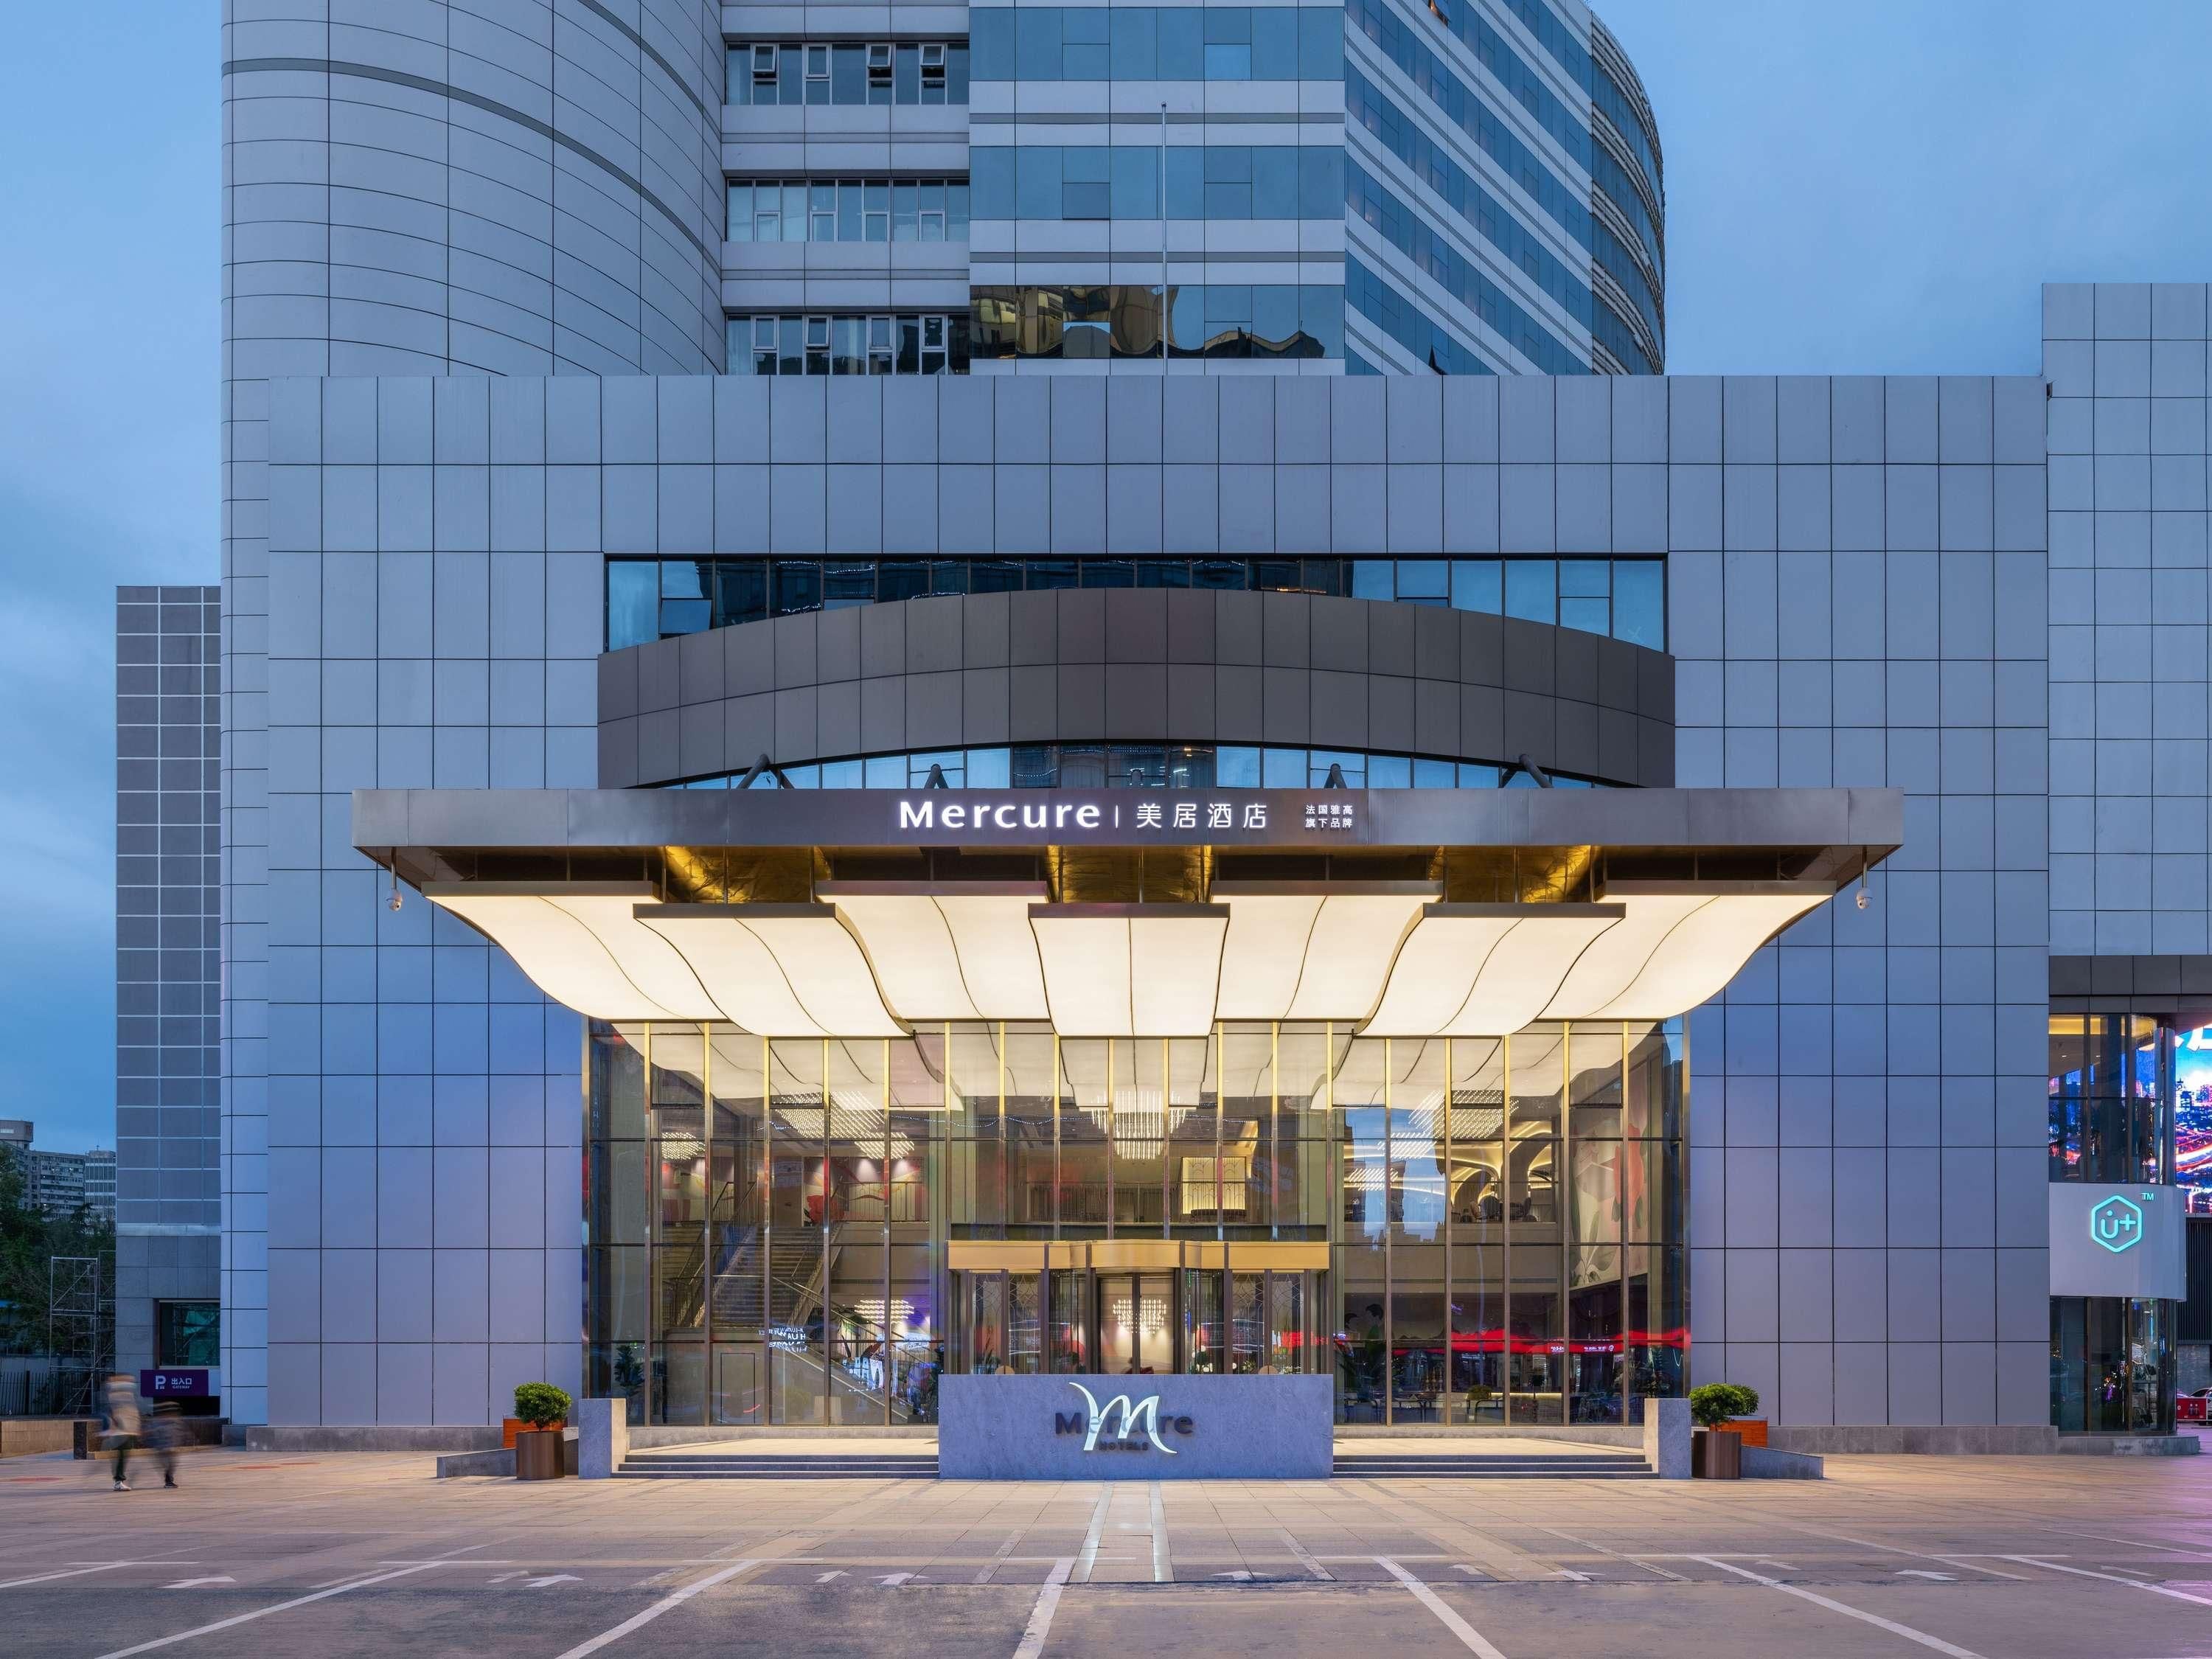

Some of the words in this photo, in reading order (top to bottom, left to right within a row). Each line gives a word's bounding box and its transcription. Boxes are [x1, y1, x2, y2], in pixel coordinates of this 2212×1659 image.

[900, 801, 1100, 828] Mercure
[1136, 802, 1267, 828] 美居酒店
[1305, 804, 1353, 815] 法国雅高
[1304, 818, 1353, 828] 旗下品牌
